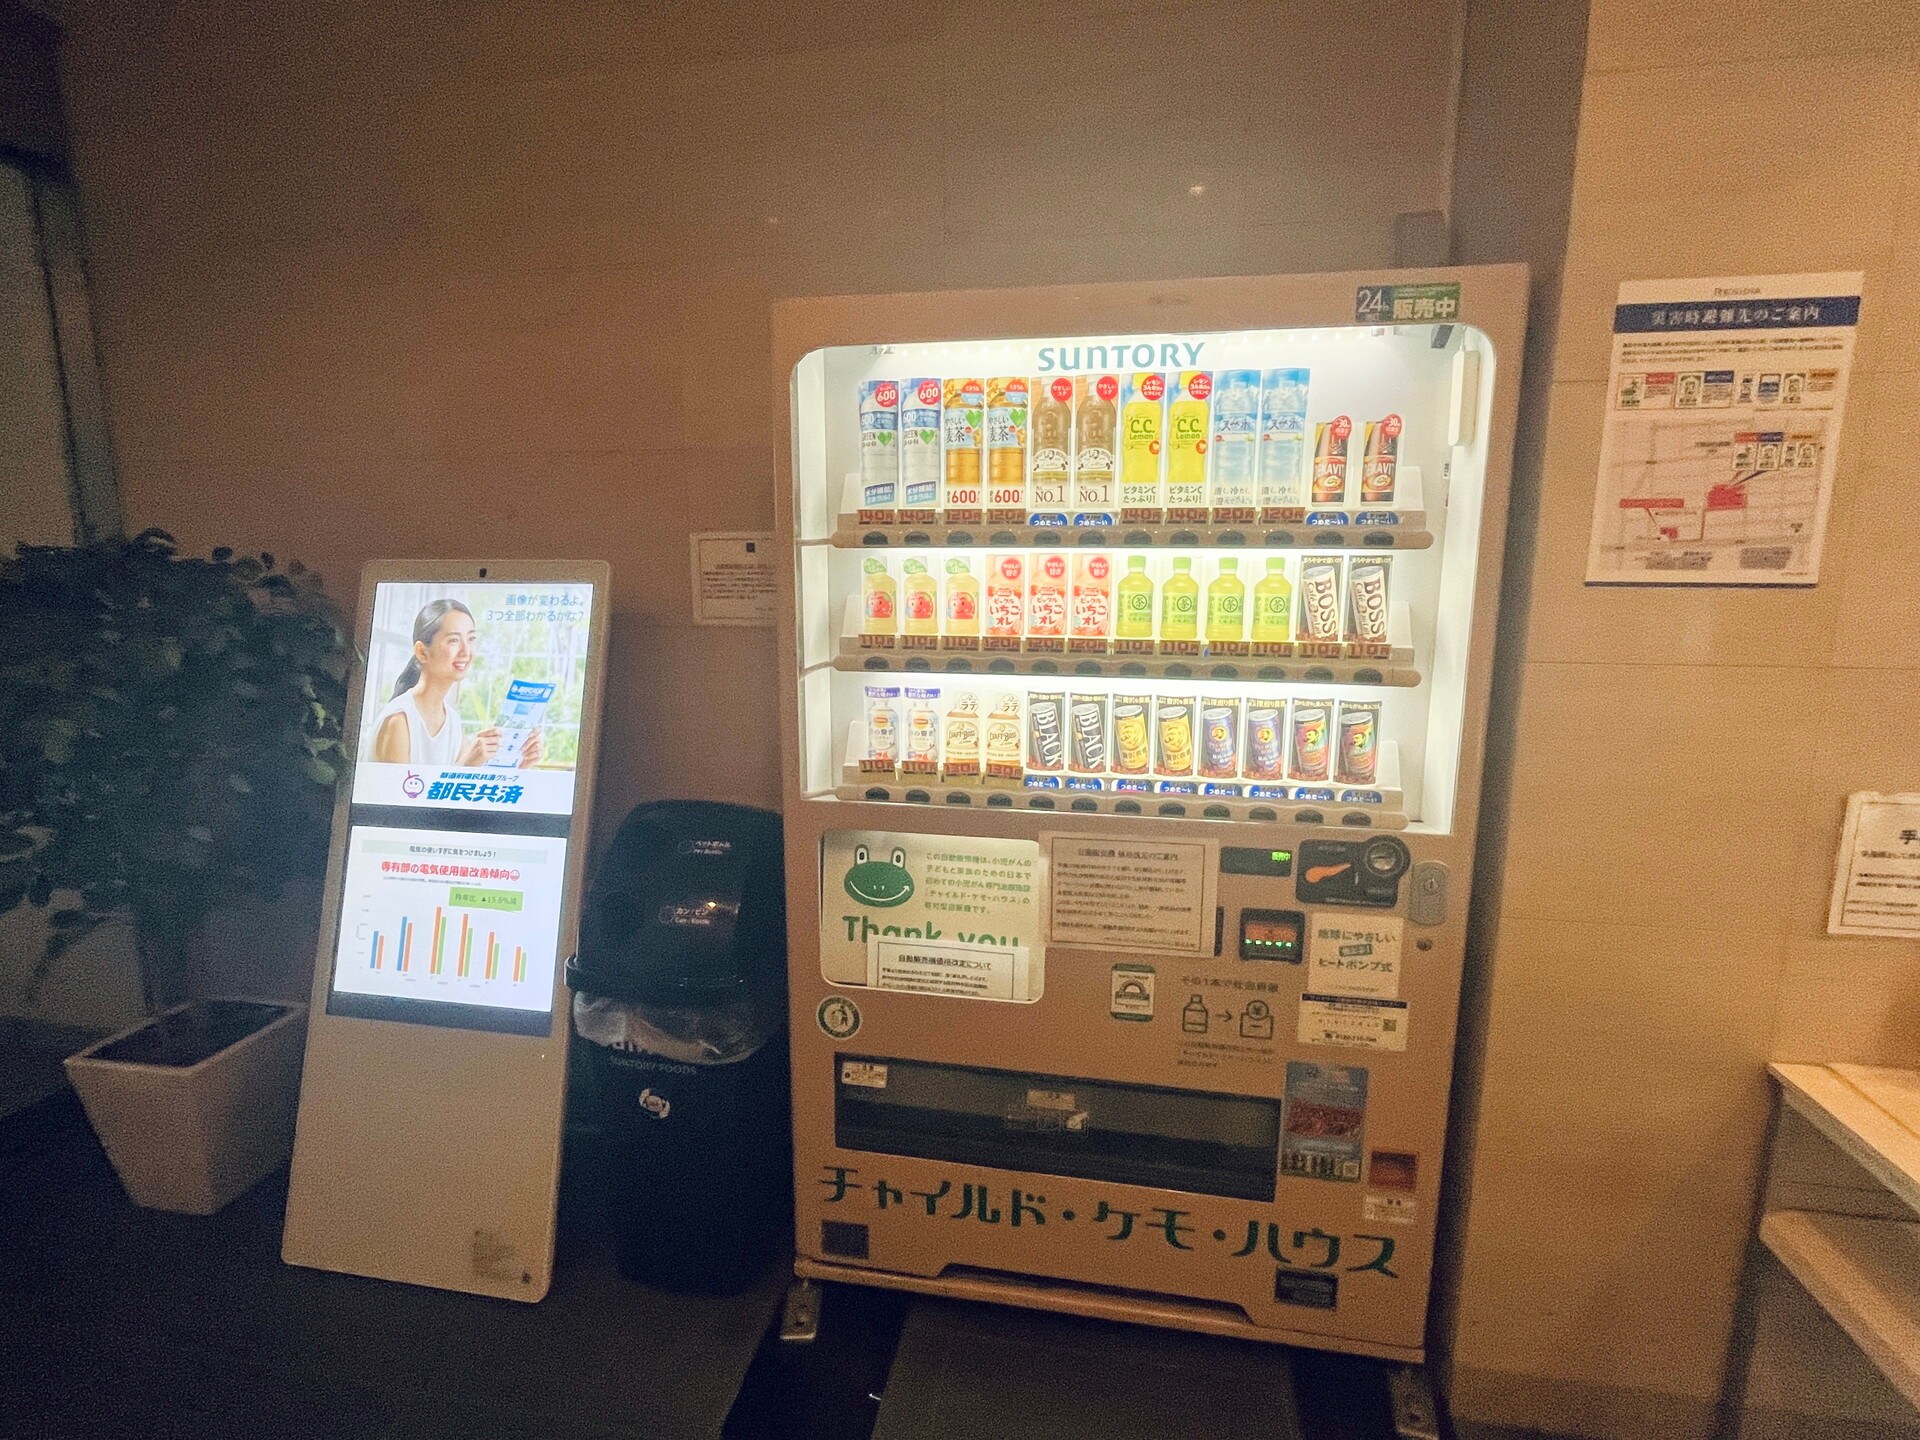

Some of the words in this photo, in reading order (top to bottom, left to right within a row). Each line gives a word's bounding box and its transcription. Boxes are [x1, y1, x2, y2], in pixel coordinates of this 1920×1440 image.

[1393, 297, 1457, 319] 販売中
[1130, 419, 1155, 433] C.C.
[1177, 418, 1203, 432] C.C.
[1221, 419, 1251, 431] 天然水
[1269, 418, 1299, 431] 天然水
[945, 426, 966, 442] 麦茶
[989, 426, 1009, 442] 麦茶
[1176, 432, 1201, 440] Lemon
[951, 489, 977, 503] 600
[994, 489, 1020, 503] 600
[1035, 485, 1065, 503] NO.1
[1079, 485, 1109, 503] NO.1
[1123, 486, 1156, 494] ビタミンC
[1170, 486, 1203, 494] ビタミンC
[505, 594, 584, 606] 画像が変わるよ。
[1315, 577, 1337, 633] BOSS
[1364, 577, 1384, 634] BOSS
[990, 605, 1020, 615] いちご
[1033, 604, 1062, 614] いちご
[1076, 605, 1107, 614] いちご
[996, 617, 1013, 625] オレ
[1039, 616, 1056, 624] オレ
[1083, 617, 1099, 625] オレ
[961, 702, 977, 711] ラテ
[1003, 703, 1017, 712] ラテ
[1037, 711, 1062, 767] BLACK
[1080, 711, 1104, 768] BLACK
[427, 781, 524, 804] 都民共済
[381, 861, 510, 881] 専有部の電気使用量改善傾向
[1318, 958, 1393, 973] ヒートポンプ式
[820, 1165, 1398, 1279] チャイルド・ケモ・ハウス
